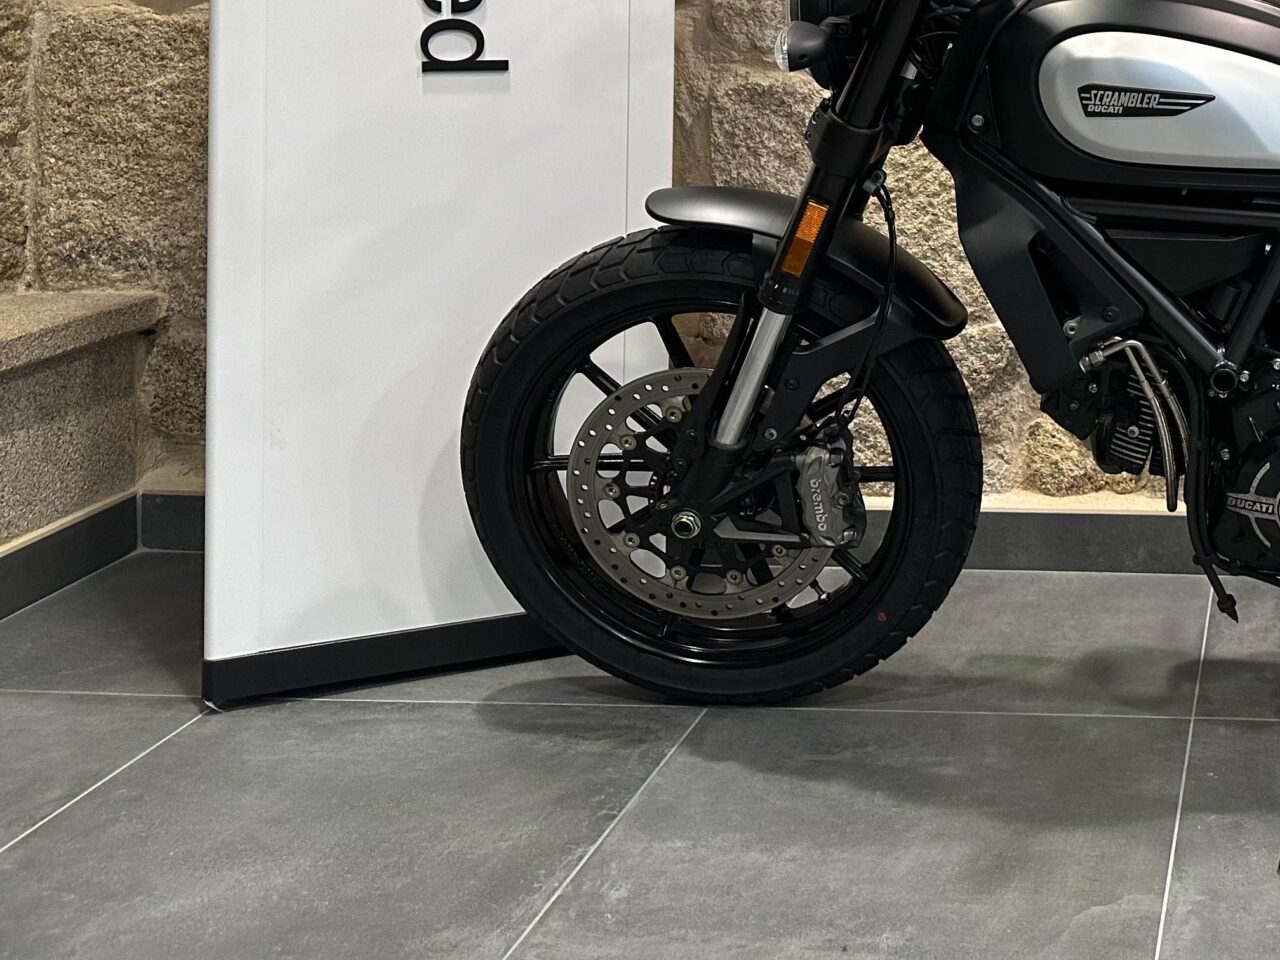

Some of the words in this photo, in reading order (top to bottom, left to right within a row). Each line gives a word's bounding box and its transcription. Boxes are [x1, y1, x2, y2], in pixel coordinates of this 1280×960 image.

[1089, 90, 1160, 108] SCRAMBLER
[1087, 104, 1123, 114] DUCATI
[809, 478, 828, 532] brembo
[1226, 496, 1274, 515] DUCATI
